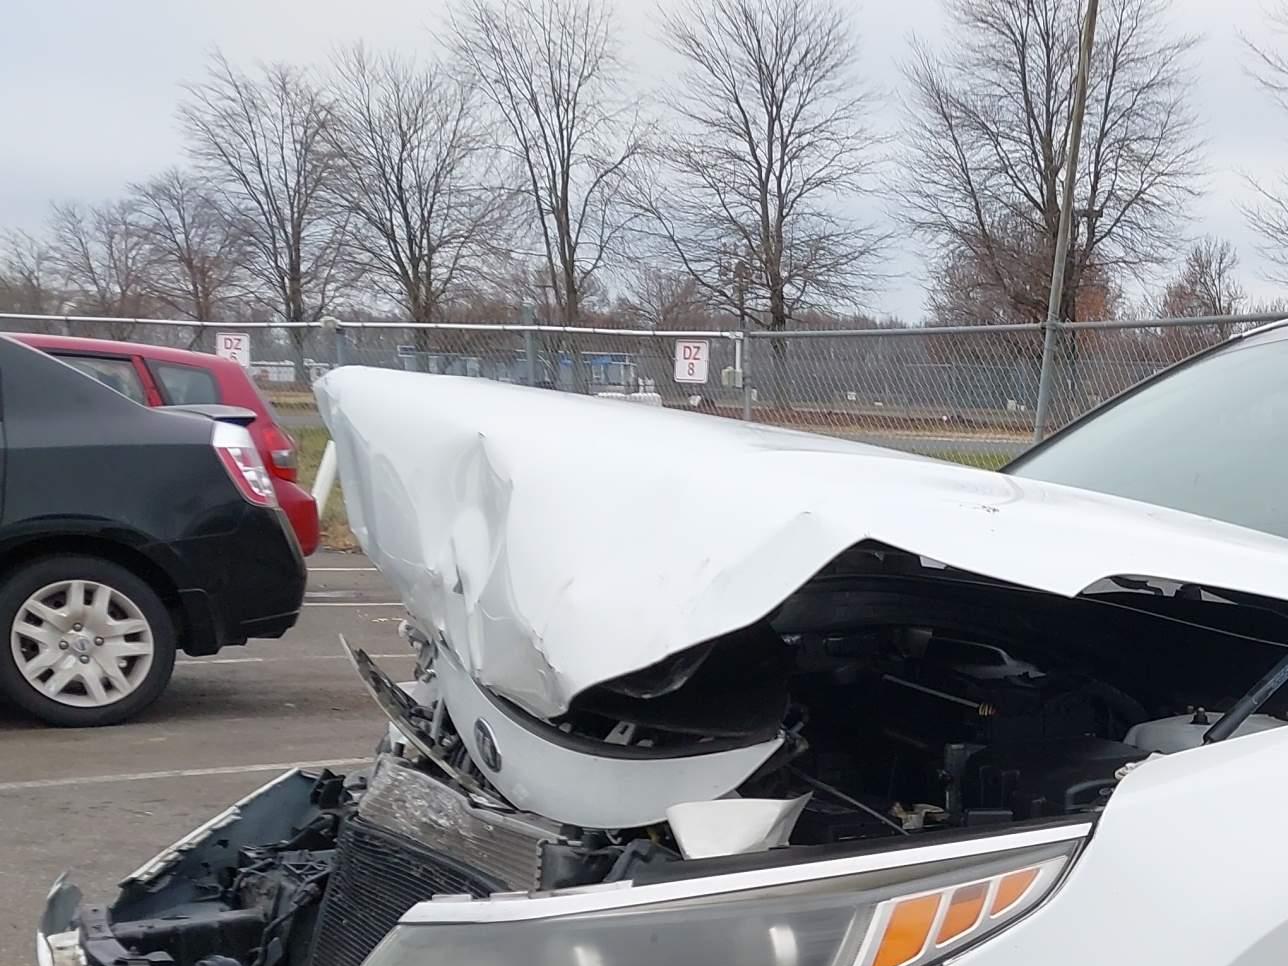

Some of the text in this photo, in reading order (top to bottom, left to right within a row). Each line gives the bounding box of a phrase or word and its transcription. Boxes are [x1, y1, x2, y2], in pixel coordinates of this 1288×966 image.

[223, 337, 242, 350] DZ
[683, 345, 701, 360] DZ
[687, 362, 695, 376] 8
